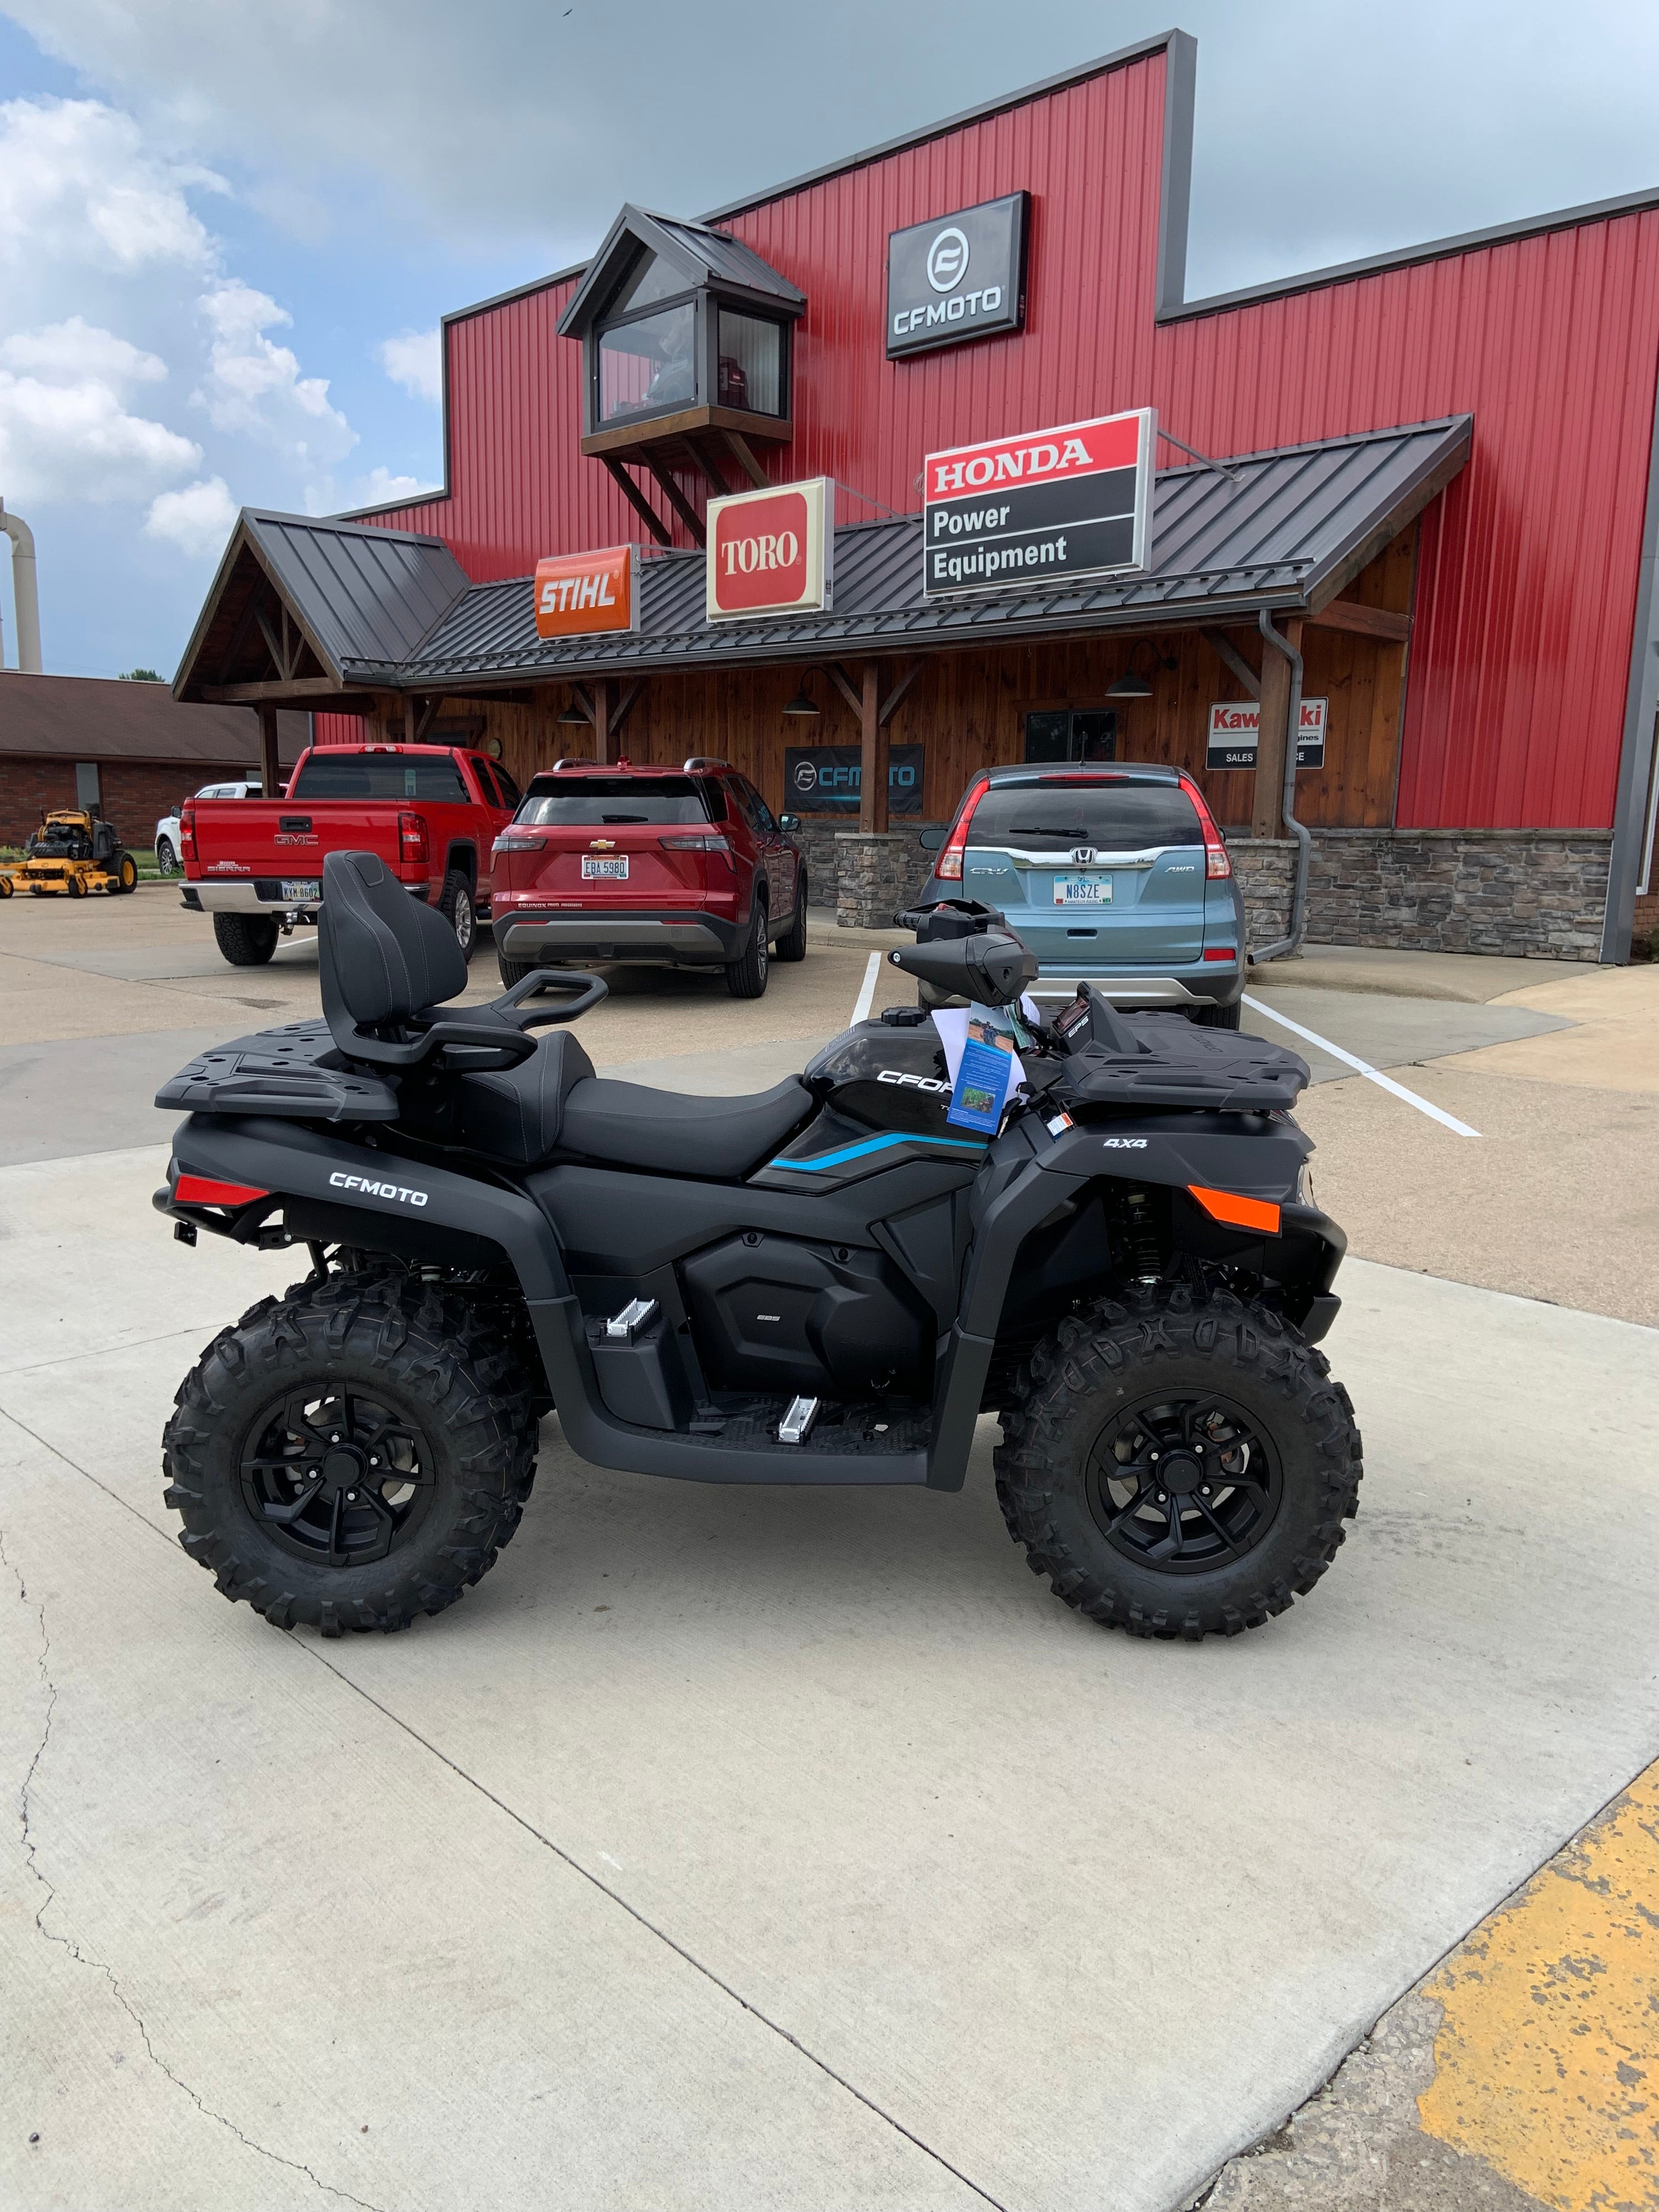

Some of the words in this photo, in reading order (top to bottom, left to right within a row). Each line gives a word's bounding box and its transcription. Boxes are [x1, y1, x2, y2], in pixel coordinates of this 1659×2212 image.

[894, 286, 1002, 335] CFMOTO
[934, 438, 1093, 493] HONDA
[934, 505, 1010, 537] Power
[721, 531, 798, 575] TORO
[934, 536, 1066, 581] Equipment
[539, 573, 616, 614] STIHL
[1214, 704, 1322, 729] Kawki
[1226, 753, 1253, 762] SALES
[819, 766, 915, 786] CFMTO
[274, 834, 319, 846] GMC
[586, 862, 601, 873] EBA
[604, 862, 624, 873] 5980
[300, 888, 318, 898] 8602
[1066, 884, 1099, 899] N8SZE
[1068, 1015, 1089, 1037] EPS
[329, 1172, 428, 1206] CFMOTO
